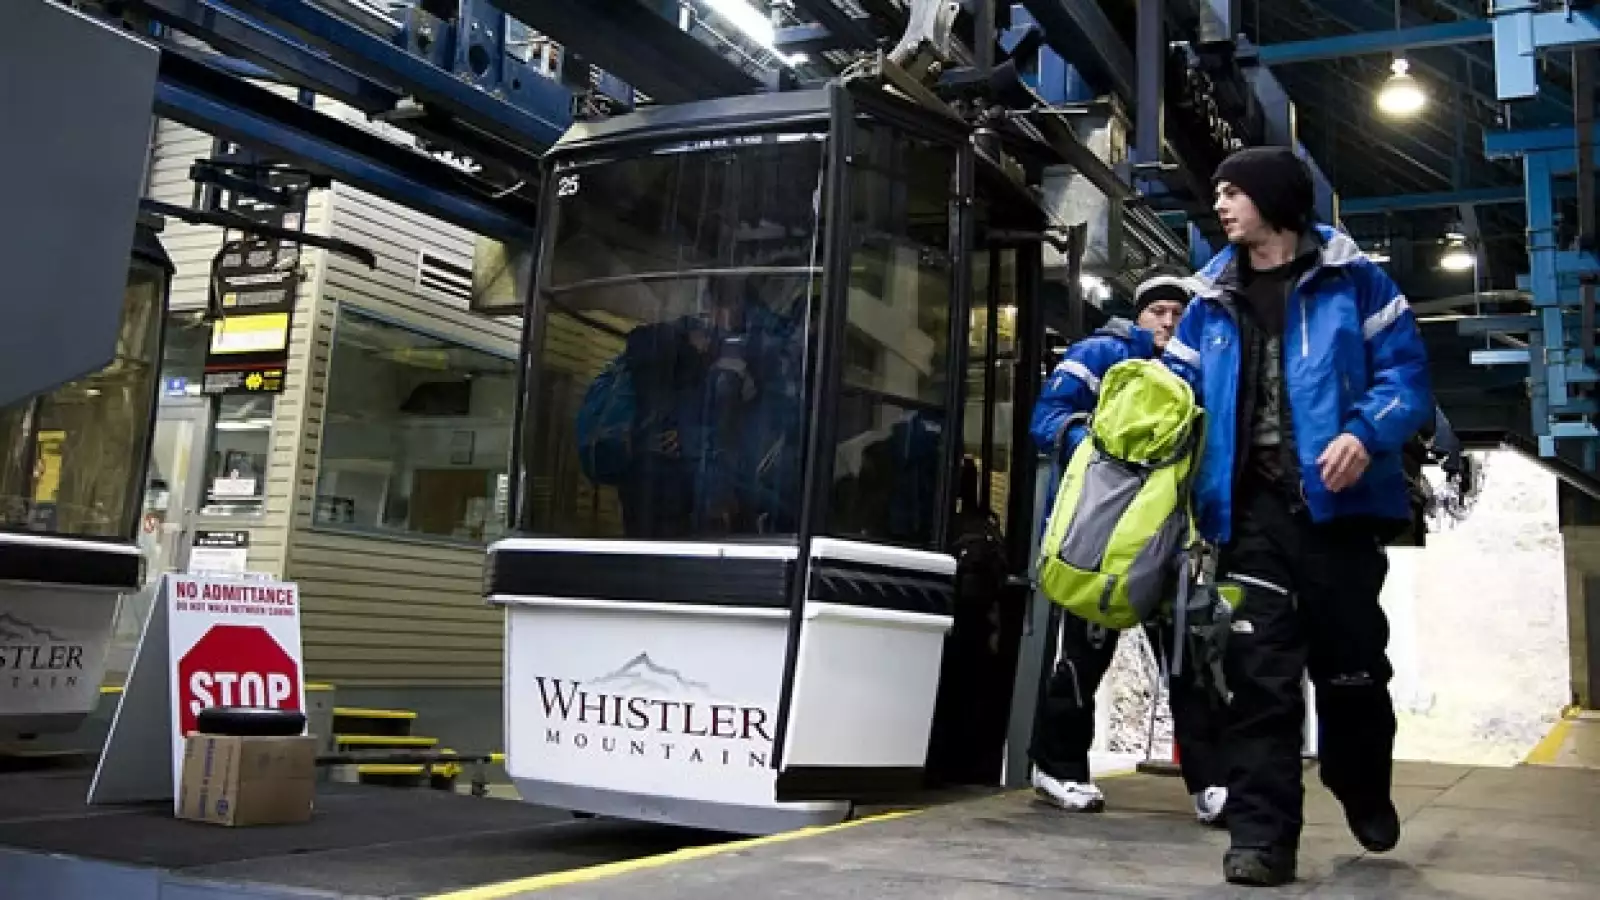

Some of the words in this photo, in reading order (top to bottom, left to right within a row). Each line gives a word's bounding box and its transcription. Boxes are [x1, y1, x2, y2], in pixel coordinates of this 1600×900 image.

[176, 581, 198, 599] NO
[202, 583, 294, 606] ADMITTANCE
[189, 671, 292, 717] STOP
[534, 675, 774, 742] WHISTLER
[545, 727, 768, 768] MOUNTAIN
